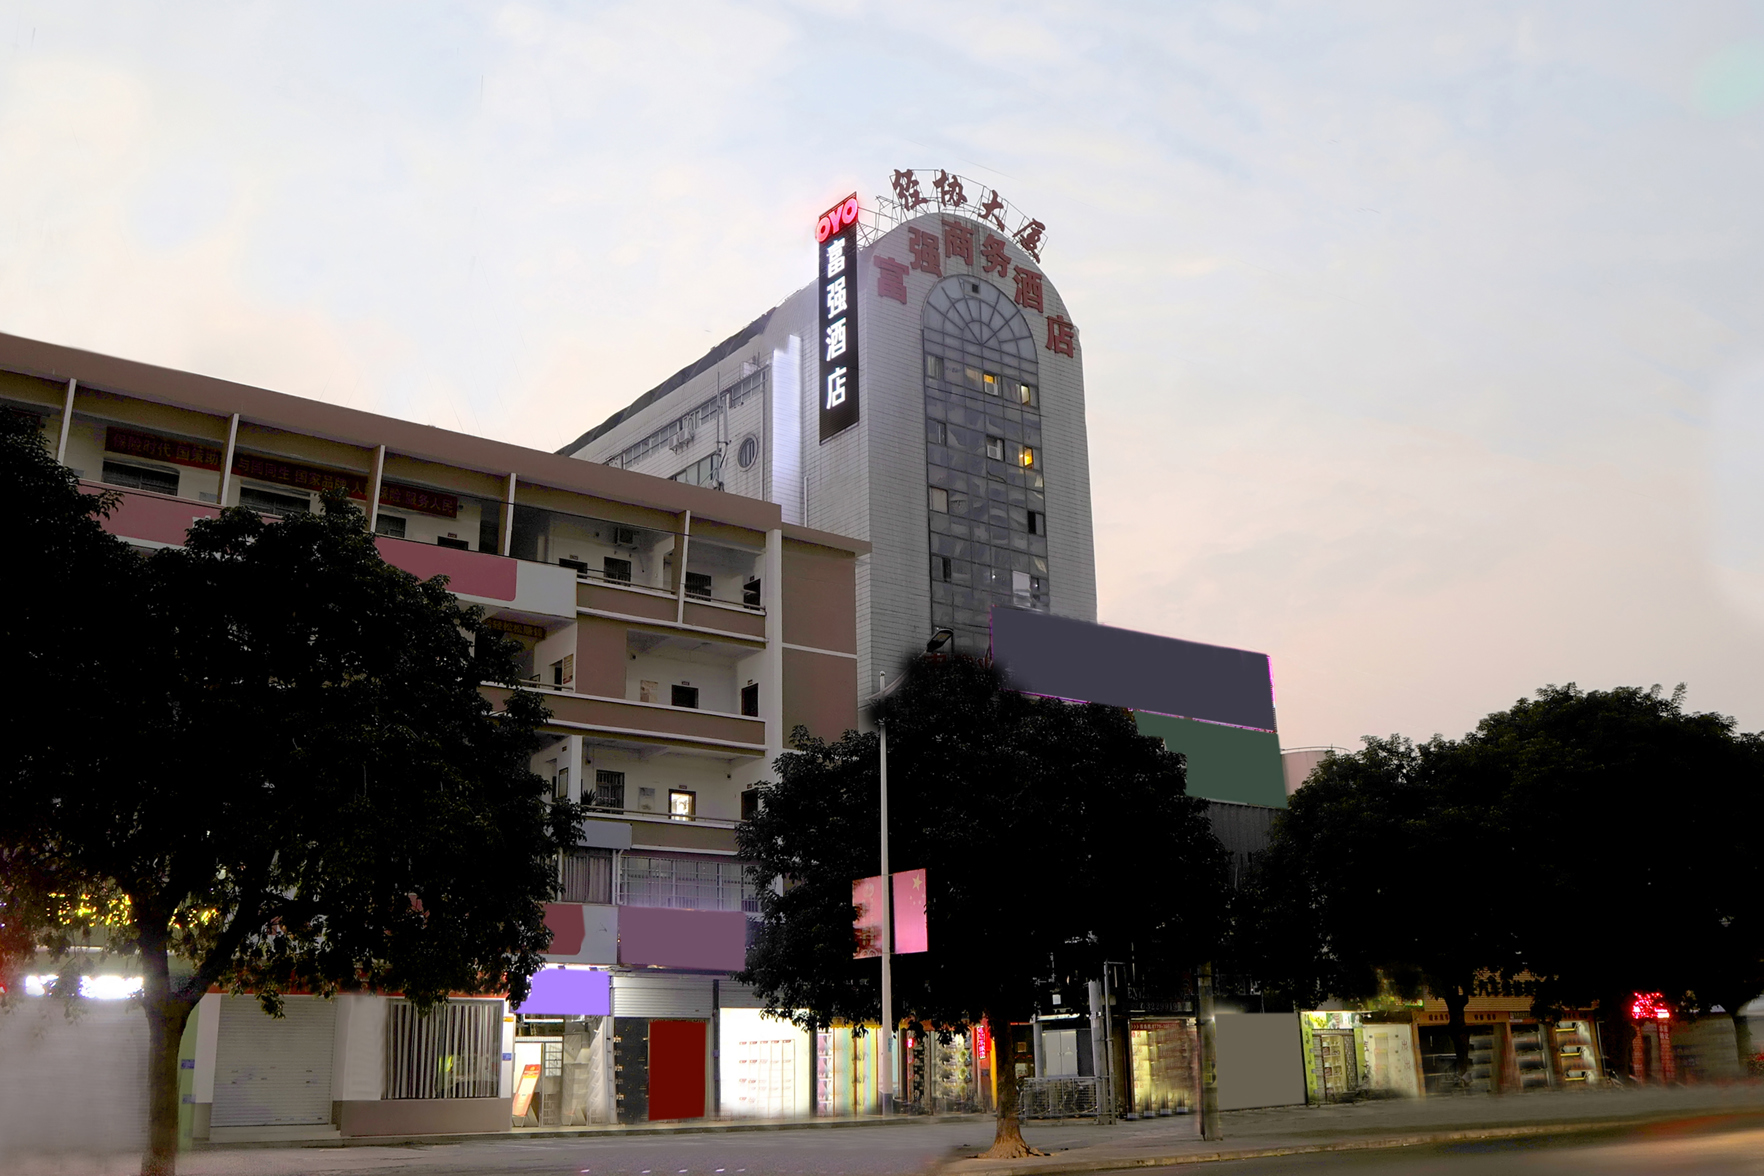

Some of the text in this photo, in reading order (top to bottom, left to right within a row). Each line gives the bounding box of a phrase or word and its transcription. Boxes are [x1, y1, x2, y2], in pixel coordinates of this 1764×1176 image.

[815, 198, 858, 243] OYO
[825, 237, 847, 410] 富强酒店
[873, 219, 1076, 359] 富强商务酒店
[174, 445, 222, 467] 国策助
